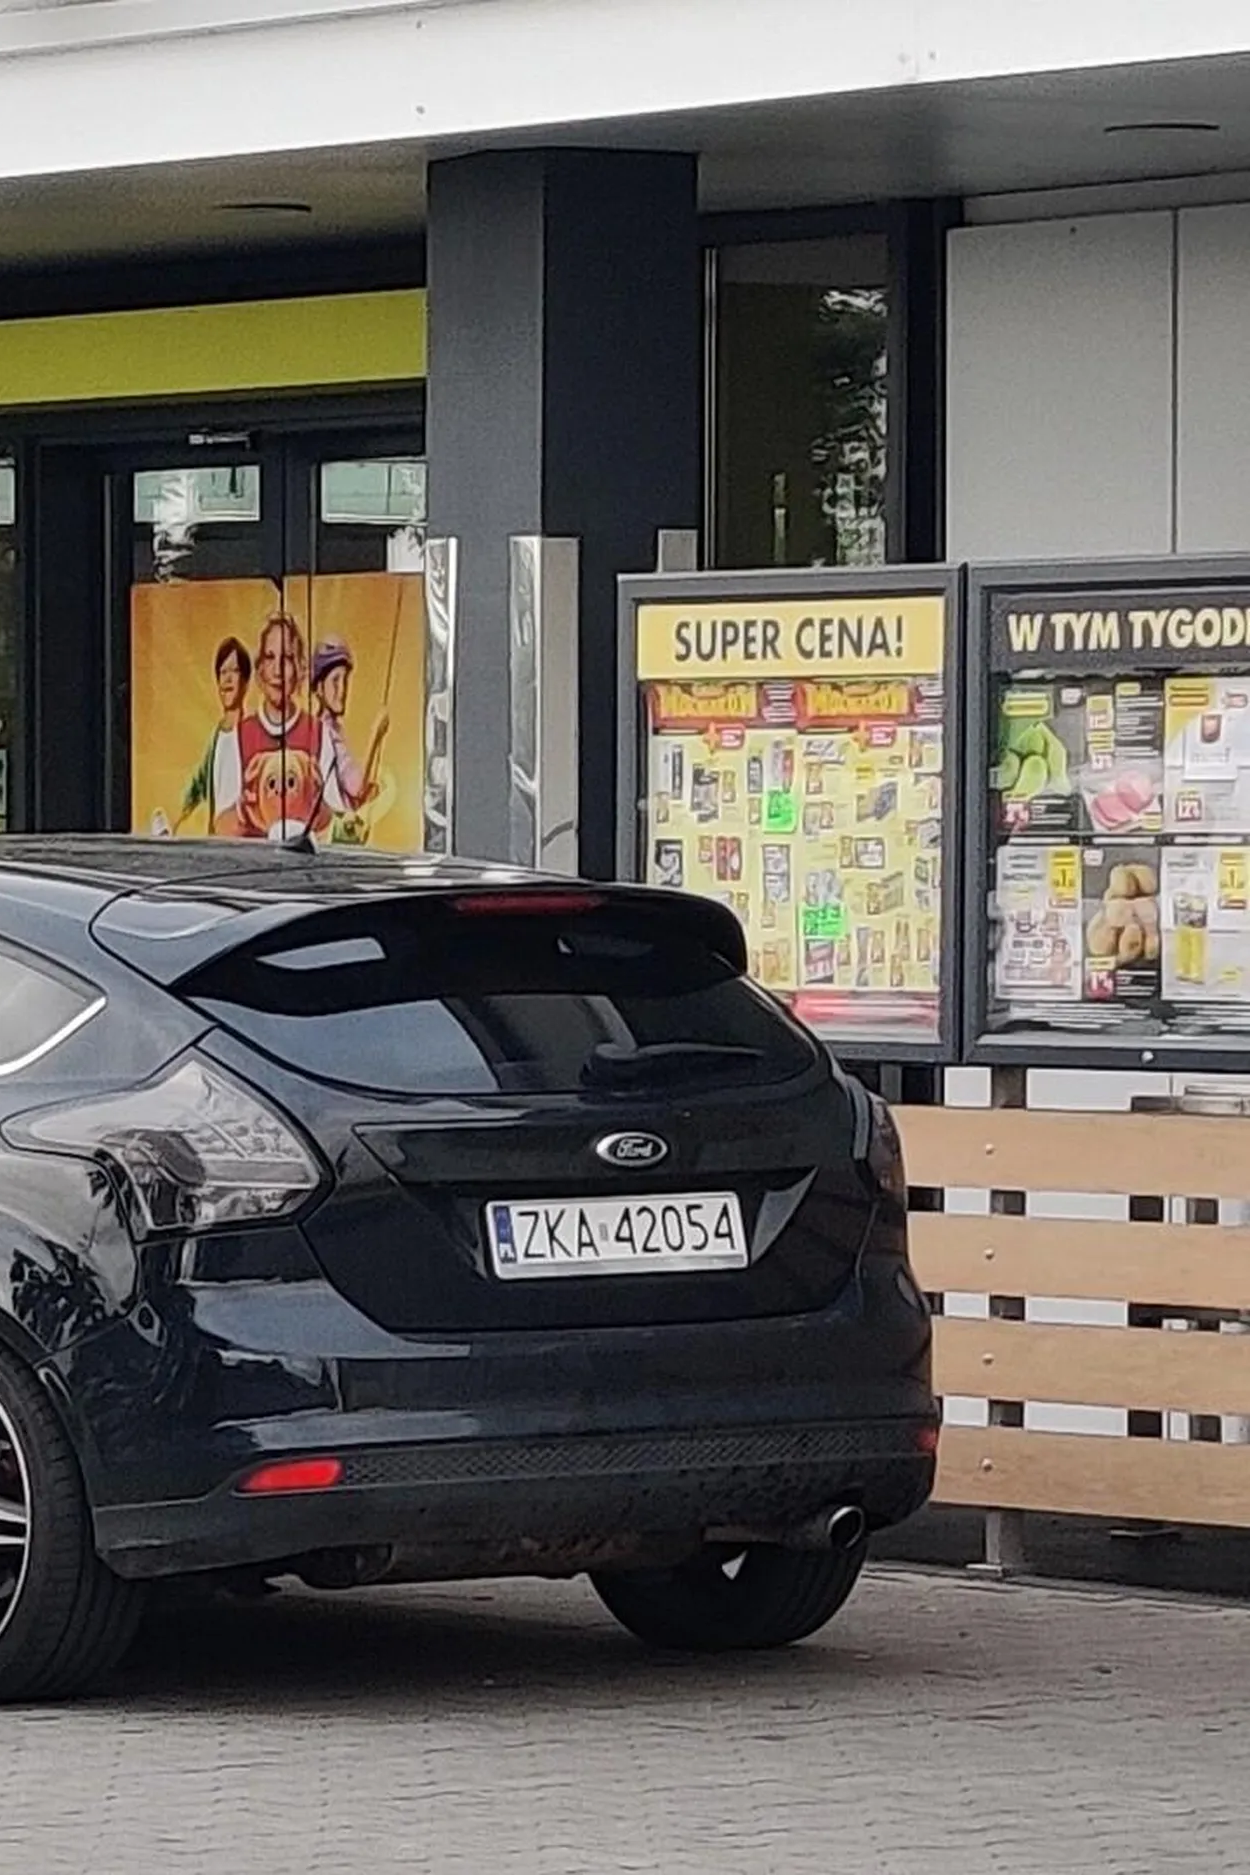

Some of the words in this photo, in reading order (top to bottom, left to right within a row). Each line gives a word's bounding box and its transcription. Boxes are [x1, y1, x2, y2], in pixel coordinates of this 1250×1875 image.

[674, 620, 782, 662] SUPER
[795, 614, 904, 660] CENA!
[1007, 613, 1043, 651] W
[1050, 611, 1121, 651] TYM
[1128, 607, 1250, 648] TYGOD
[617, 1139, 653, 1157] Ford
[517, 1208, 600, 1258] ZKA
[613, 1202, 736, 1254] 42054
